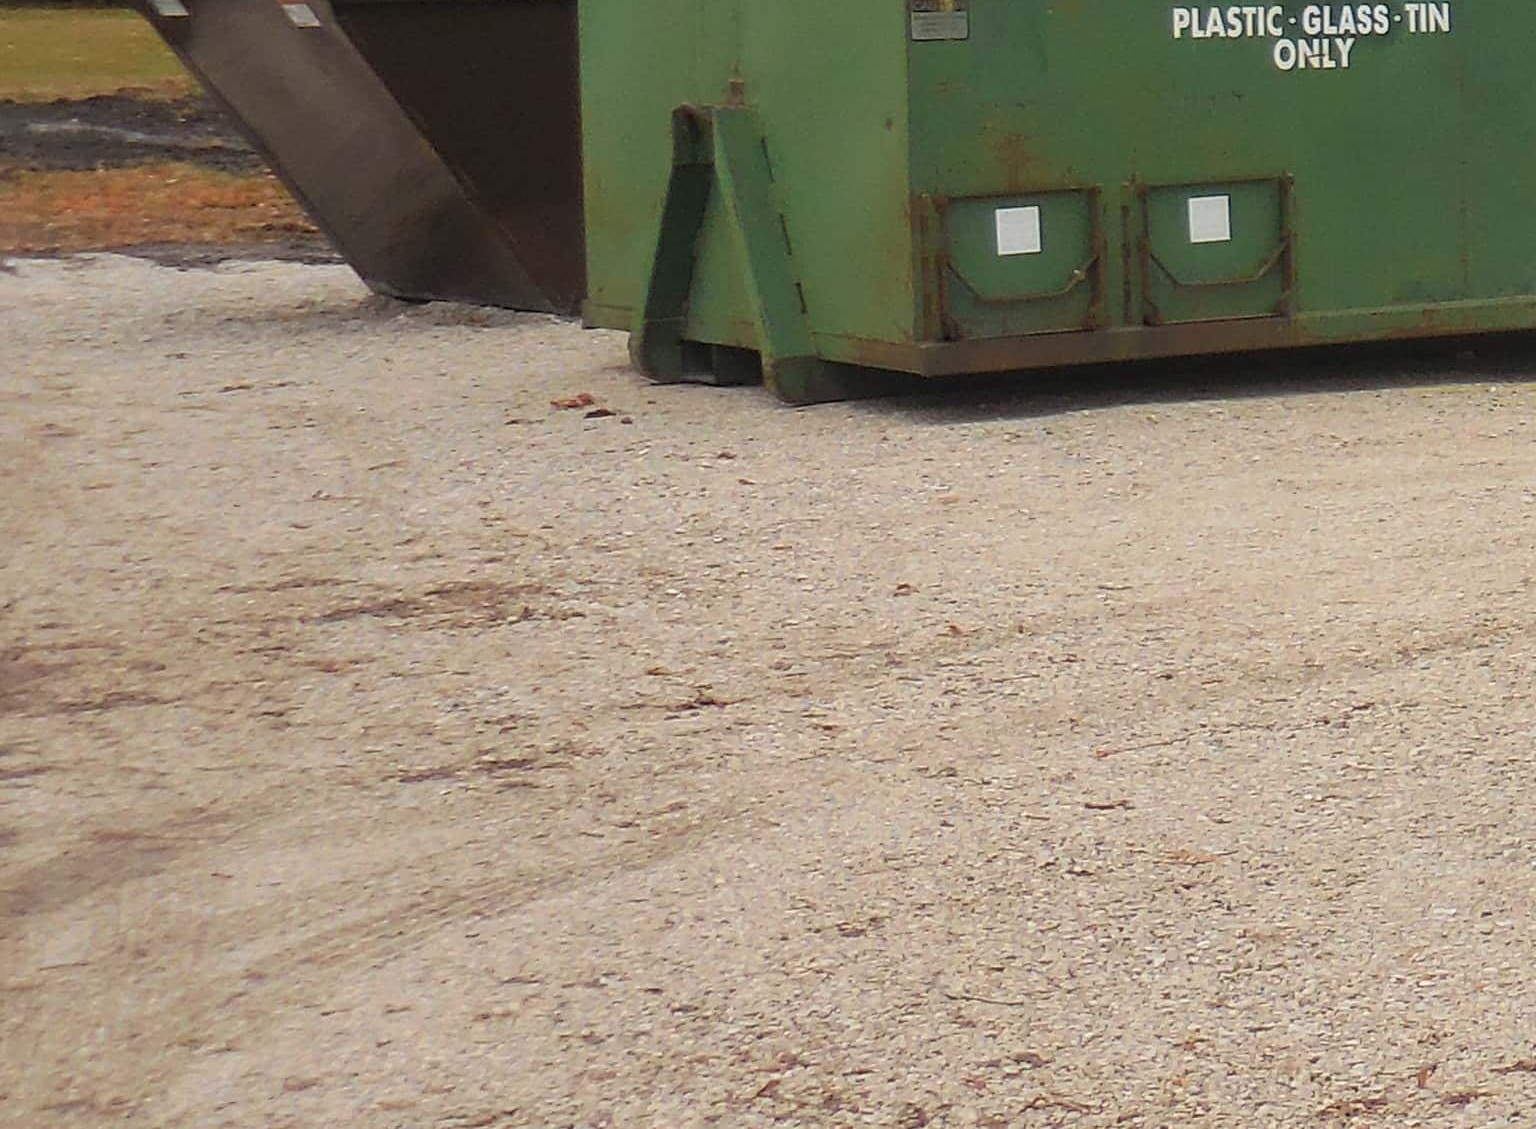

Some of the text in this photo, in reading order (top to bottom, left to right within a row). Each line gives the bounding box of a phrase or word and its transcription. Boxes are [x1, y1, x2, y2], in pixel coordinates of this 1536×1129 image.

[1172, 2, 1450, 39] PLASTIC GLASS TIN
[1272, 37, 1355, 70] ONLY
